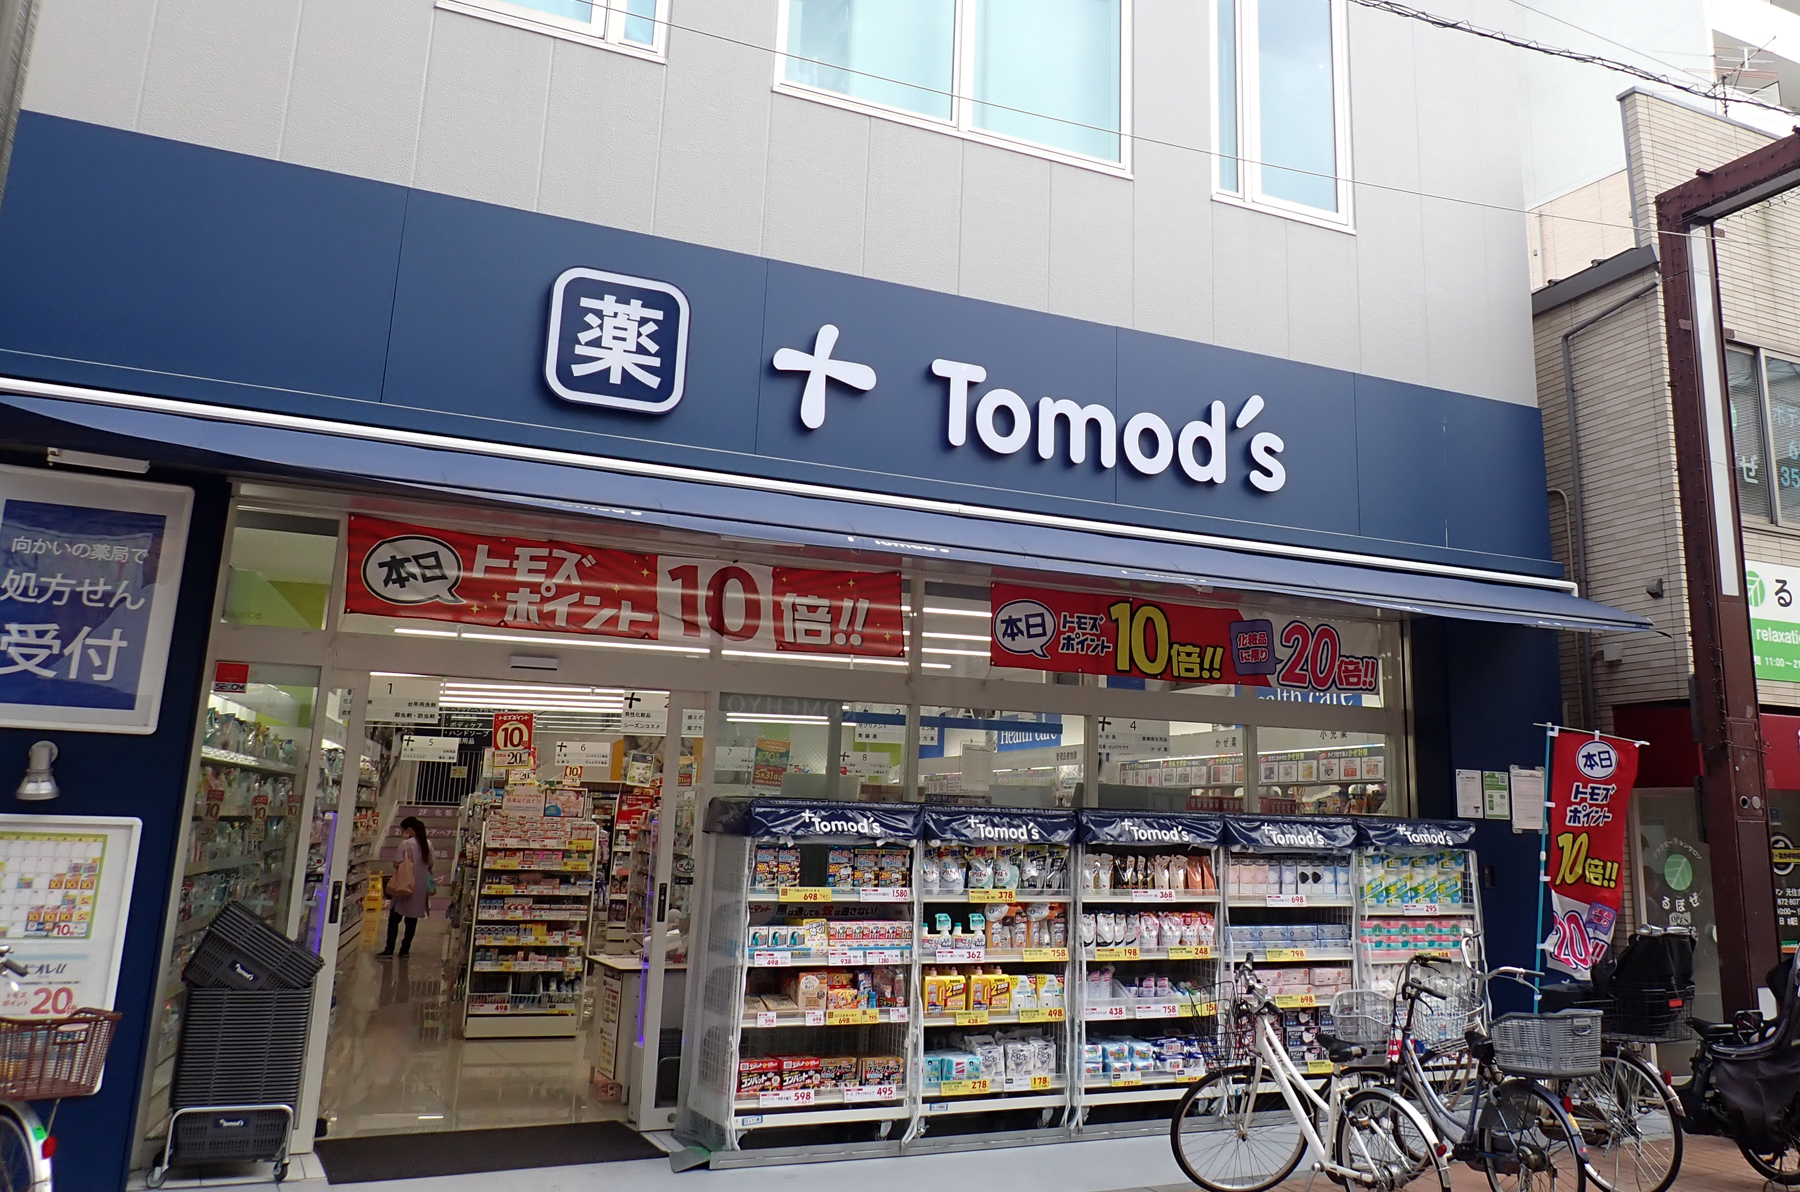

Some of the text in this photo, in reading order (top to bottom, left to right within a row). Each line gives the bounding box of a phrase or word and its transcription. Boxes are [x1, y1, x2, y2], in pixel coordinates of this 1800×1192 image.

[571, 294, 663, 389] 薬
[932, 358, 1287, 492] Tomod's
[11, 536, 150, 565] 向かいの薬局で
[473, 543, 597, 586] トモズ
[378, 551, 448, 590] 本日
[0, 568, 146, 611] 処方せん
[504, 582, 654, 633] ポイント
[999, 612, 1047, 643] 本日
[1060, 612, 1105, 633] トモズ
[1058, 633, 1113, 656] ポイント
[1236, 632, 1268, 649] 化粧品
[0, 621, 128, 682] 受付
[1238, 648, 1270, 664] に限り
[215, 682, 245, 691] SECOM
[387, 682, 393, 695] 1
[623, 722, 661, 730] シーズンコスメ
[1129, 720, 1138, 731] 4
[428, 738, 434, 747] 5
[580, 743, 587, 752] 6
[1215, 736, 1238, 748] かぜ薬
[862, 753, 868, 762] 8
[1582, 750, 1613, 770] 本日
[1573, 782, 1617, 804] トモズ
[1566, 803, 1612, 826] ポイント
[812, 816, 881, 834] Tomod's
[976, 822, 1040, 841] Tomod's
[1130, 825, 1189, 842] Tomod's
[1270, 830, 1325, 846] Tomod's
[1404, 830, 1453, 846] Tomod's
[803, 893, 818, 901] 698
[891, 889, 908, 898] 1580
[998, 891, 1013, 900] 378
[1159, 891, 1173, 899] 368
[1290, 895, 1304, 904] 698
[966, 950, 981, 959] 362
[1050, 949, 1066, 957] 758
[1123, 948, 1137, 957] 198
[1194, 947, 1209, 955] 248
[1290, 949, 1305, 958] 798
[1300, 995, 1314, 1003] 698
[494, 1004, 509, 1012] 498
[1047, 1009, 1063, 1017] 498
[1108, 1007, 1124, 1016] 438
[1162, 1005, 1177, 1013] 758
[838, 1017, 850, 1025] 698
[741, 1073, 768, 1088] コンバット
[783, 1072, 809, 1086] コンバット
[971, 1080, 987, 1089] 278
[1032, 1077, 1048, 1085] 178
[794, 1091, 812, 1101] 598
[876, 1086, 894, 1096] 495
